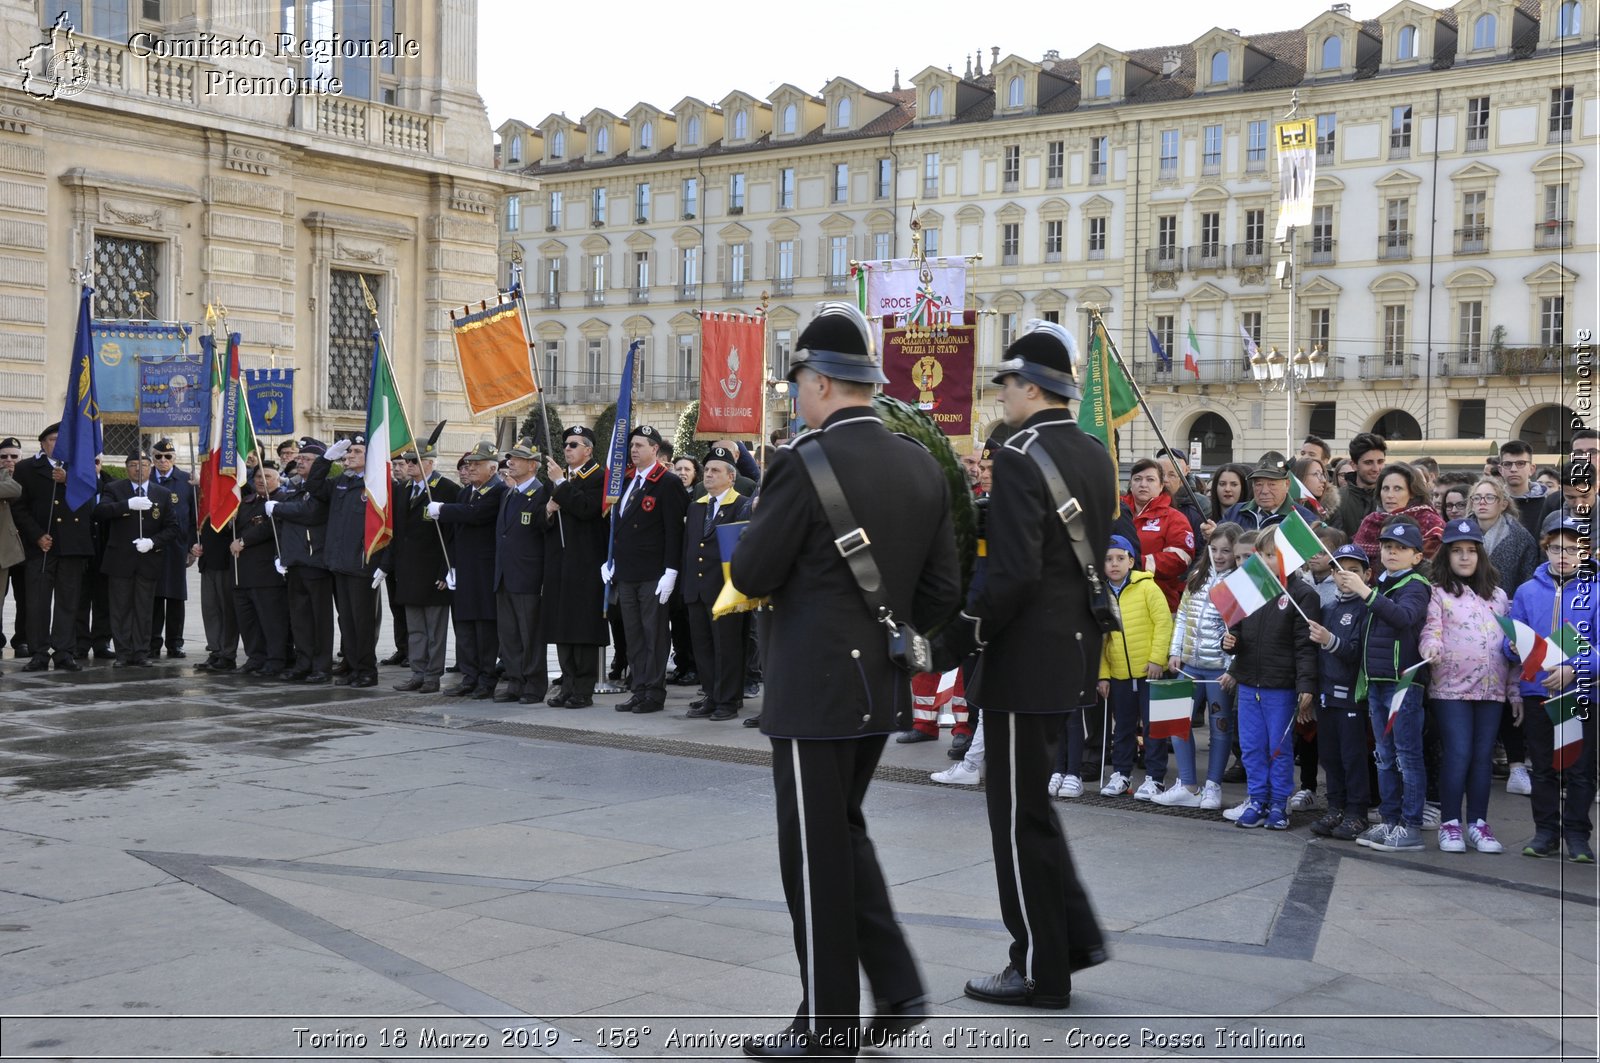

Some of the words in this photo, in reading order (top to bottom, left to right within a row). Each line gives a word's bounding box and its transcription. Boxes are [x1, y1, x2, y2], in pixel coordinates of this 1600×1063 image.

[880, 297, 912, 309] CROCE
[901, 345, 926, 355] POLIZIA
[928, 345, 935, 354] DI
[937, 345, 958, 354] STATO
[1091, 349, 1101, 384] SEZIONE
[1092, 386, 1102, 395] DI
[933, 413, 963, 423] TORINO
[1093, 397, 1105, 427] TORINO
[615, 418, 627, 448] TORINO
[614, 450, 623, 459] DI
[610, 461, 623, 494] SEZIONE
